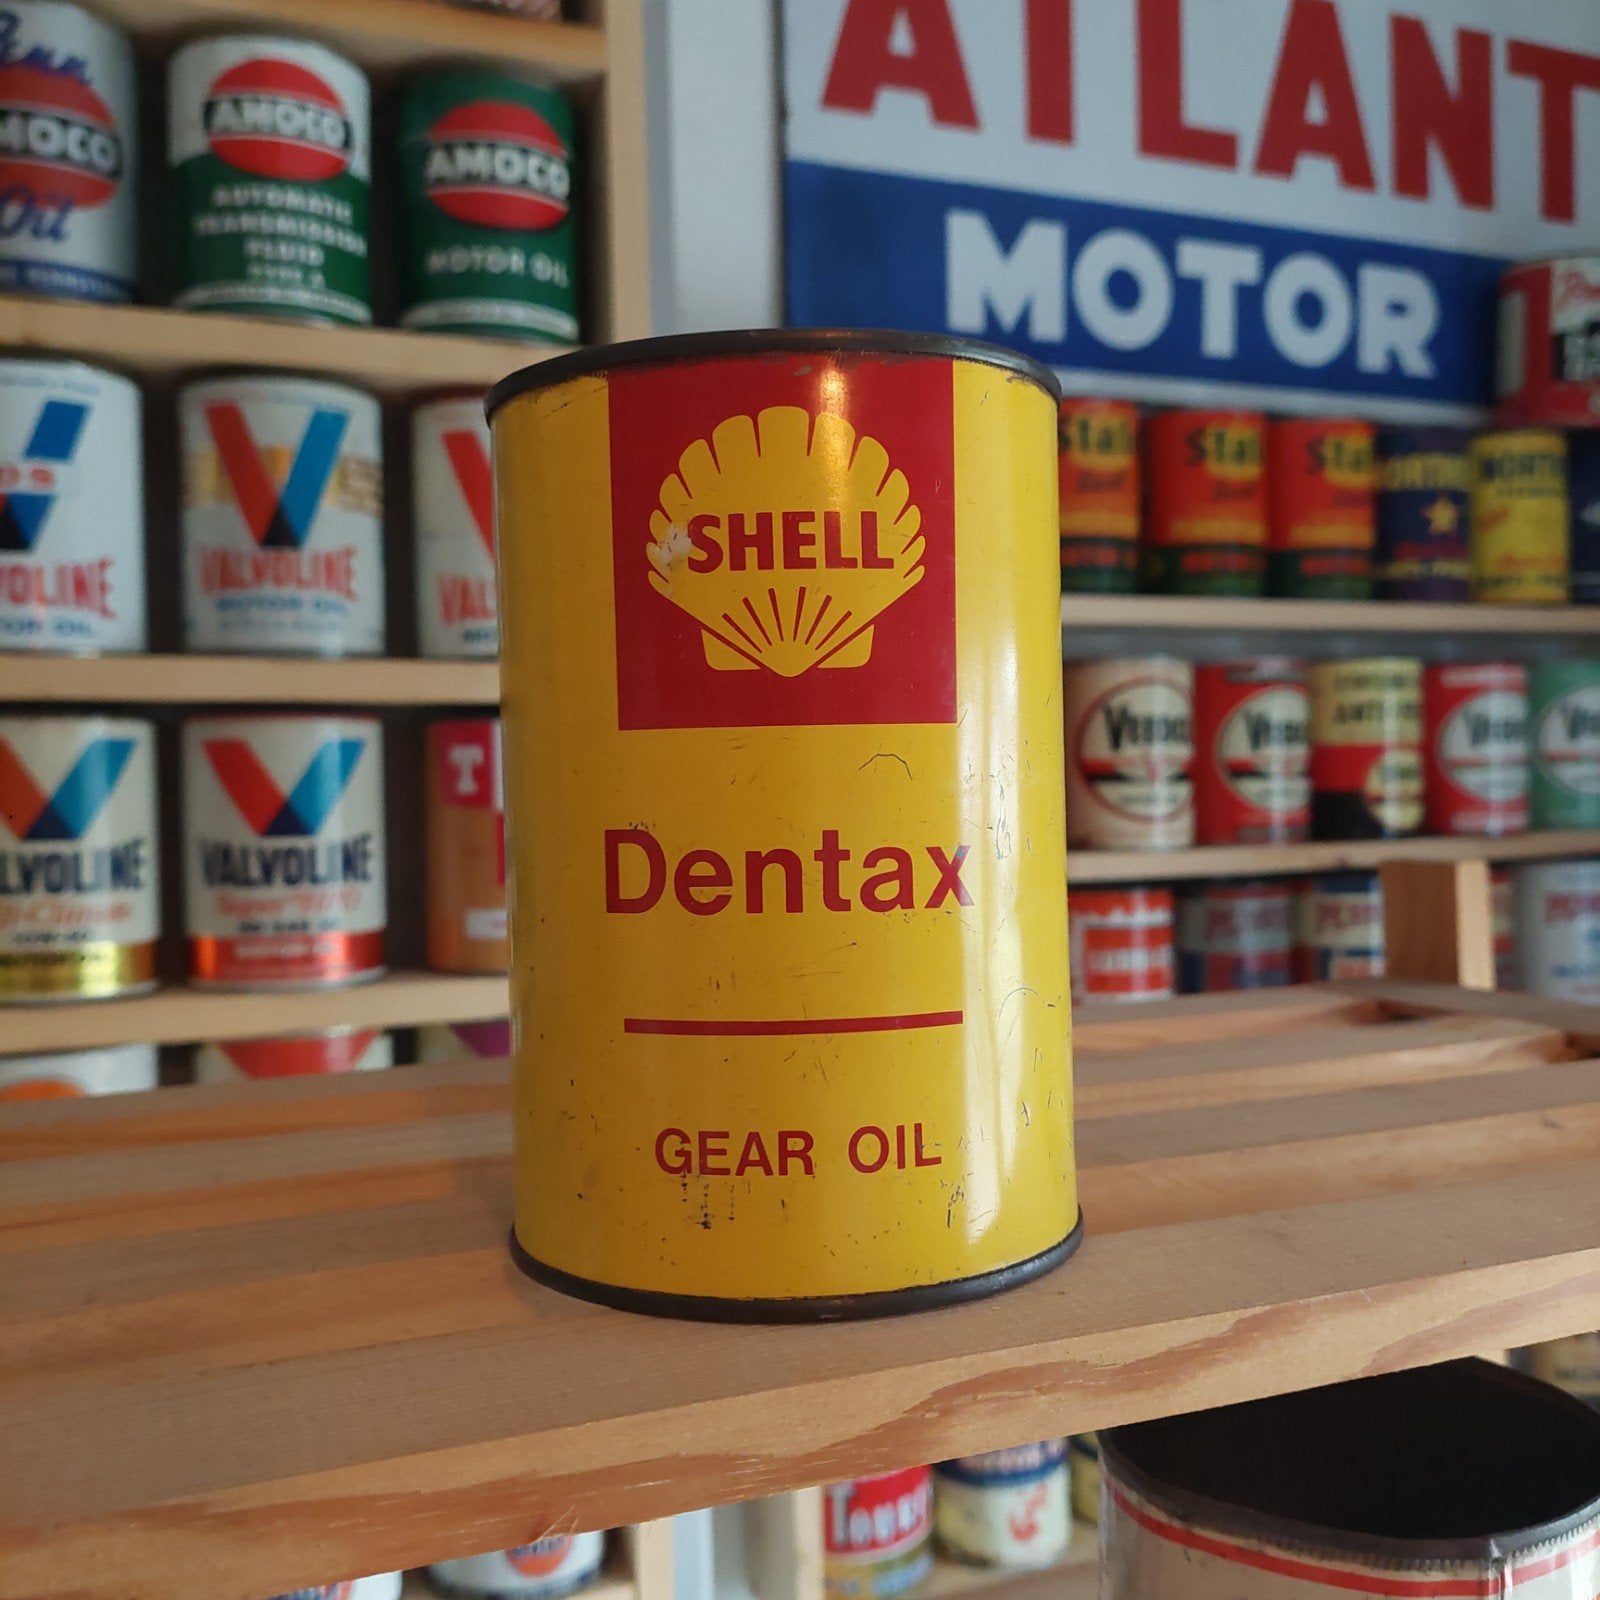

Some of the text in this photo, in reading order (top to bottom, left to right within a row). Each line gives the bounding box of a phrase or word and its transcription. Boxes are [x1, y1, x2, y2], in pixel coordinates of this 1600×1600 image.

[208, 97, 346, 150] AMOCO
[424, 145, 570, 200] AMOCO
[945, 208, 1439, 380] MOTOR
[687, 510, 895, 573] SHELL
[199, 832, 373, 888] VALVOLINE
[604, 828, 976, 916] Dentax
[655, 1122, 943, 1177] GEAR OIL
